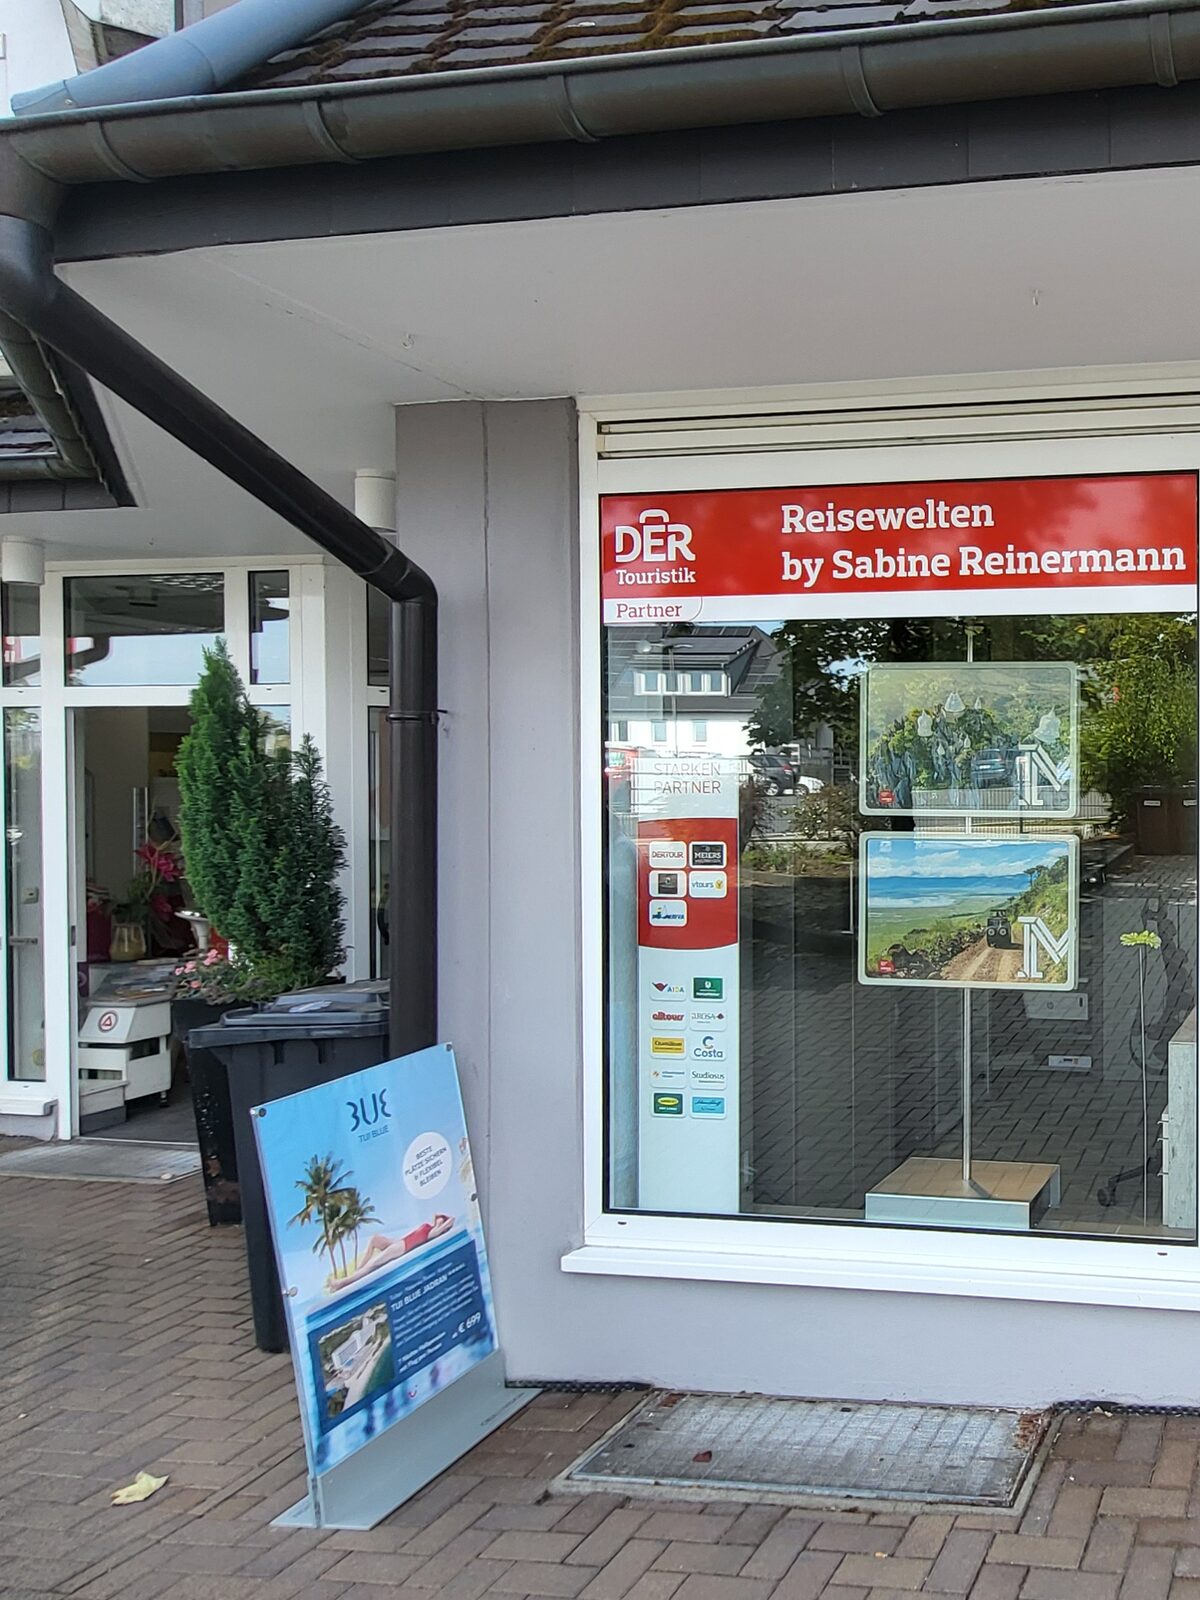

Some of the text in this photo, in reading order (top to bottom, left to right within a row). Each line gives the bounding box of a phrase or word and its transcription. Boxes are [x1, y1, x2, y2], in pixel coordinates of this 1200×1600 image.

[781, 499, 995, 534] Reisewelten
[615, 524, 696, 564] DER
[781, 544, 1187, 588] by Sabine Reinermann
[615, 567, 697, 586] Touristik
[615, 602, 683, 620] Partner
[653, 763, 721, 776] STARKEN
[653, 780, 721, 794] PARTNER
[652, 851, 683, 859] DERTOUR
[694, 851, 721, 859] MEIERS
[693, 1048, 723, 1058] Costa
[691, 1071, 725, 1080] Studiosus
[404, 1289, 422, 1305] BLUE
